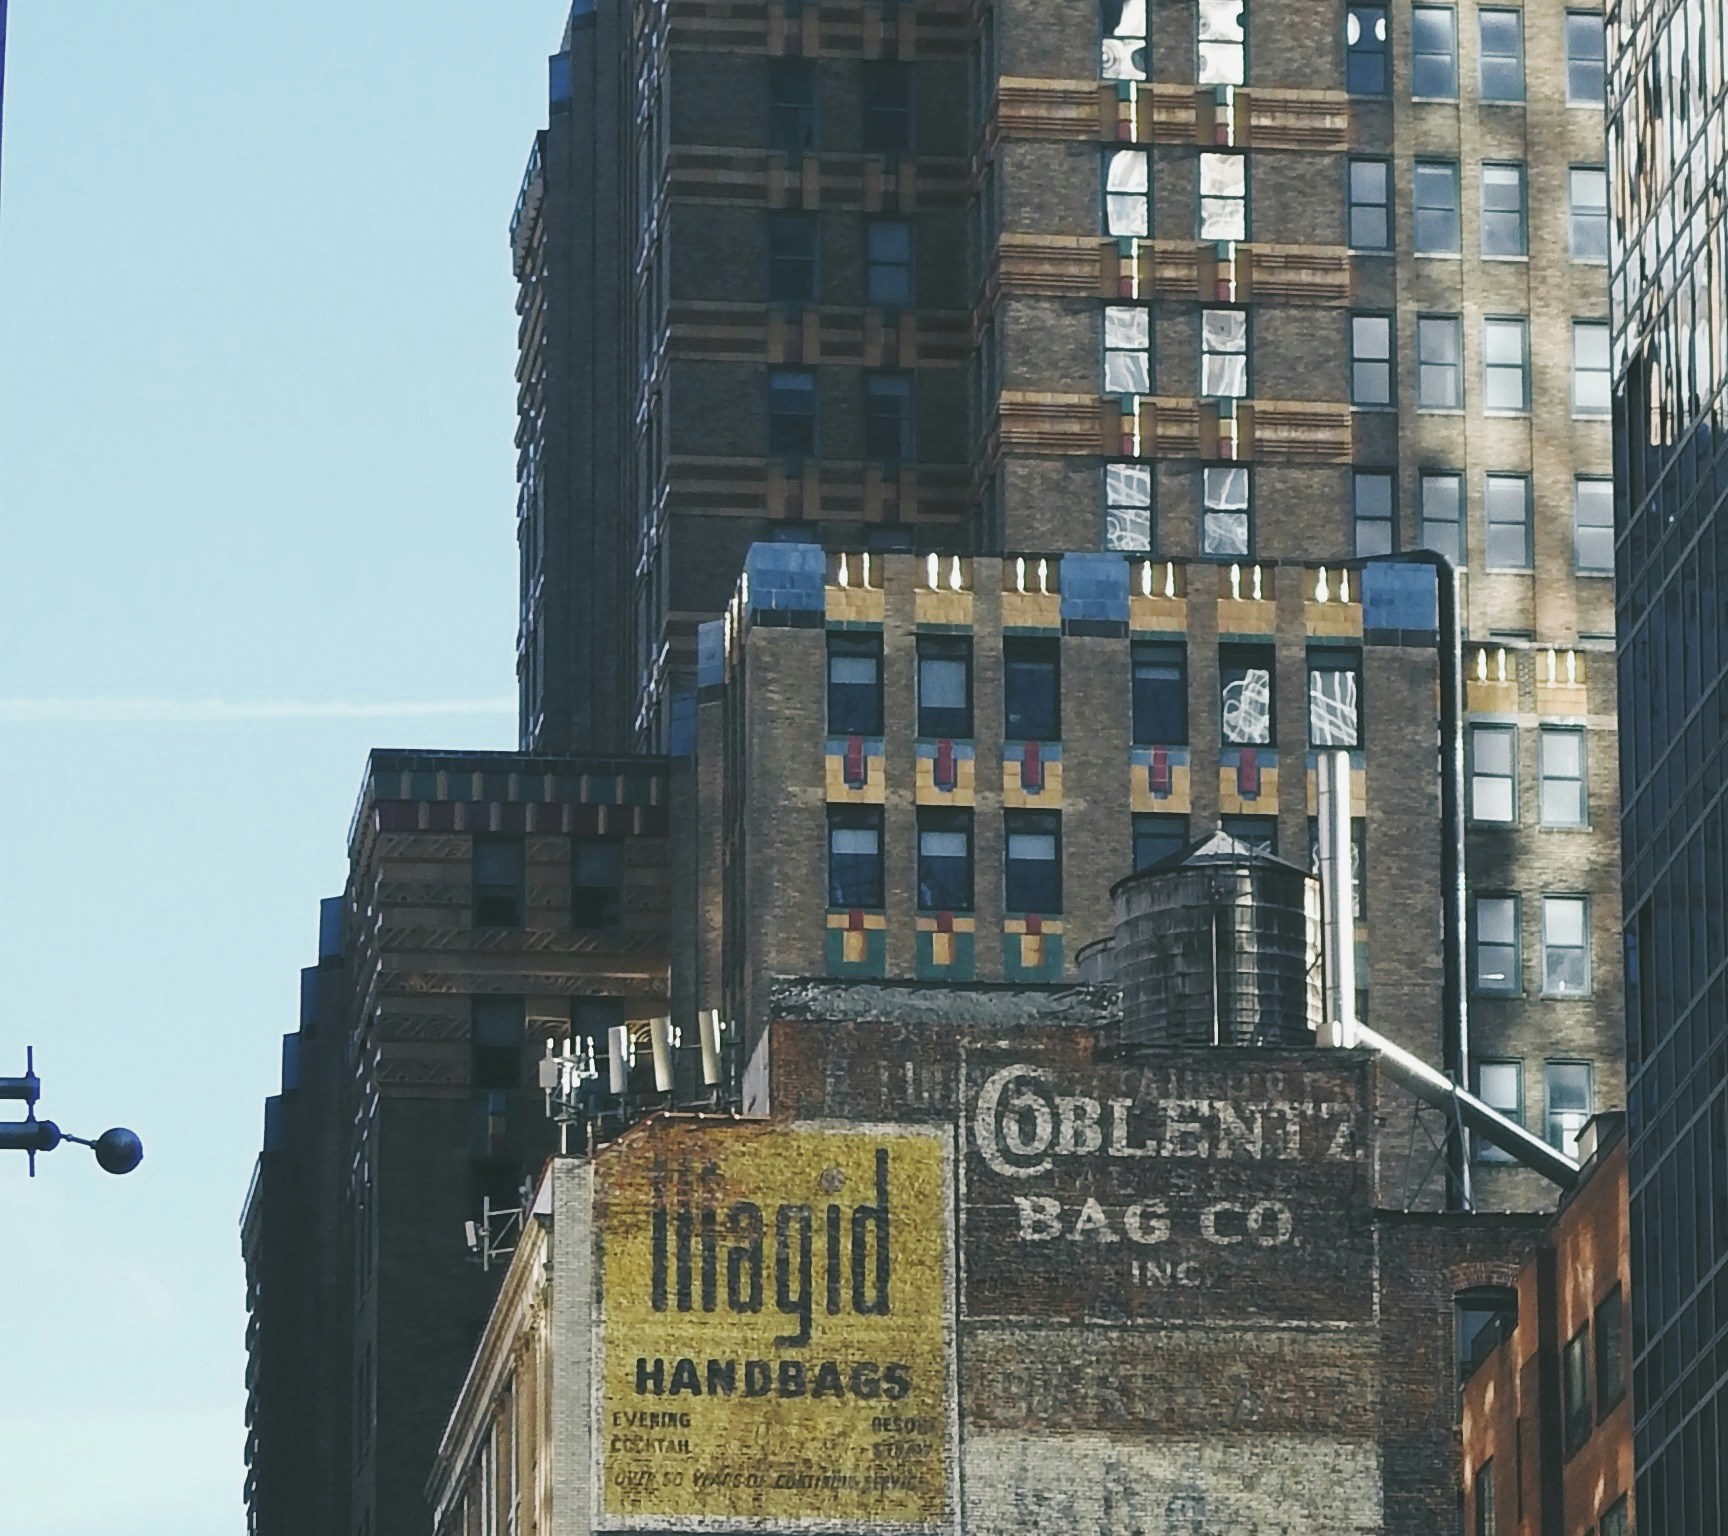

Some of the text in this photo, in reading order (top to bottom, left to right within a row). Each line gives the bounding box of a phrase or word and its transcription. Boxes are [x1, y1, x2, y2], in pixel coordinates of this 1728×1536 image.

[975, 1063, 1365, 1177] COBLENTZ
[1015, 1196, 1172, 1245] BAG
[635, 1357, 912, 1399] HANDBAGS
[612, 1411, 691, 1430] EVENING
